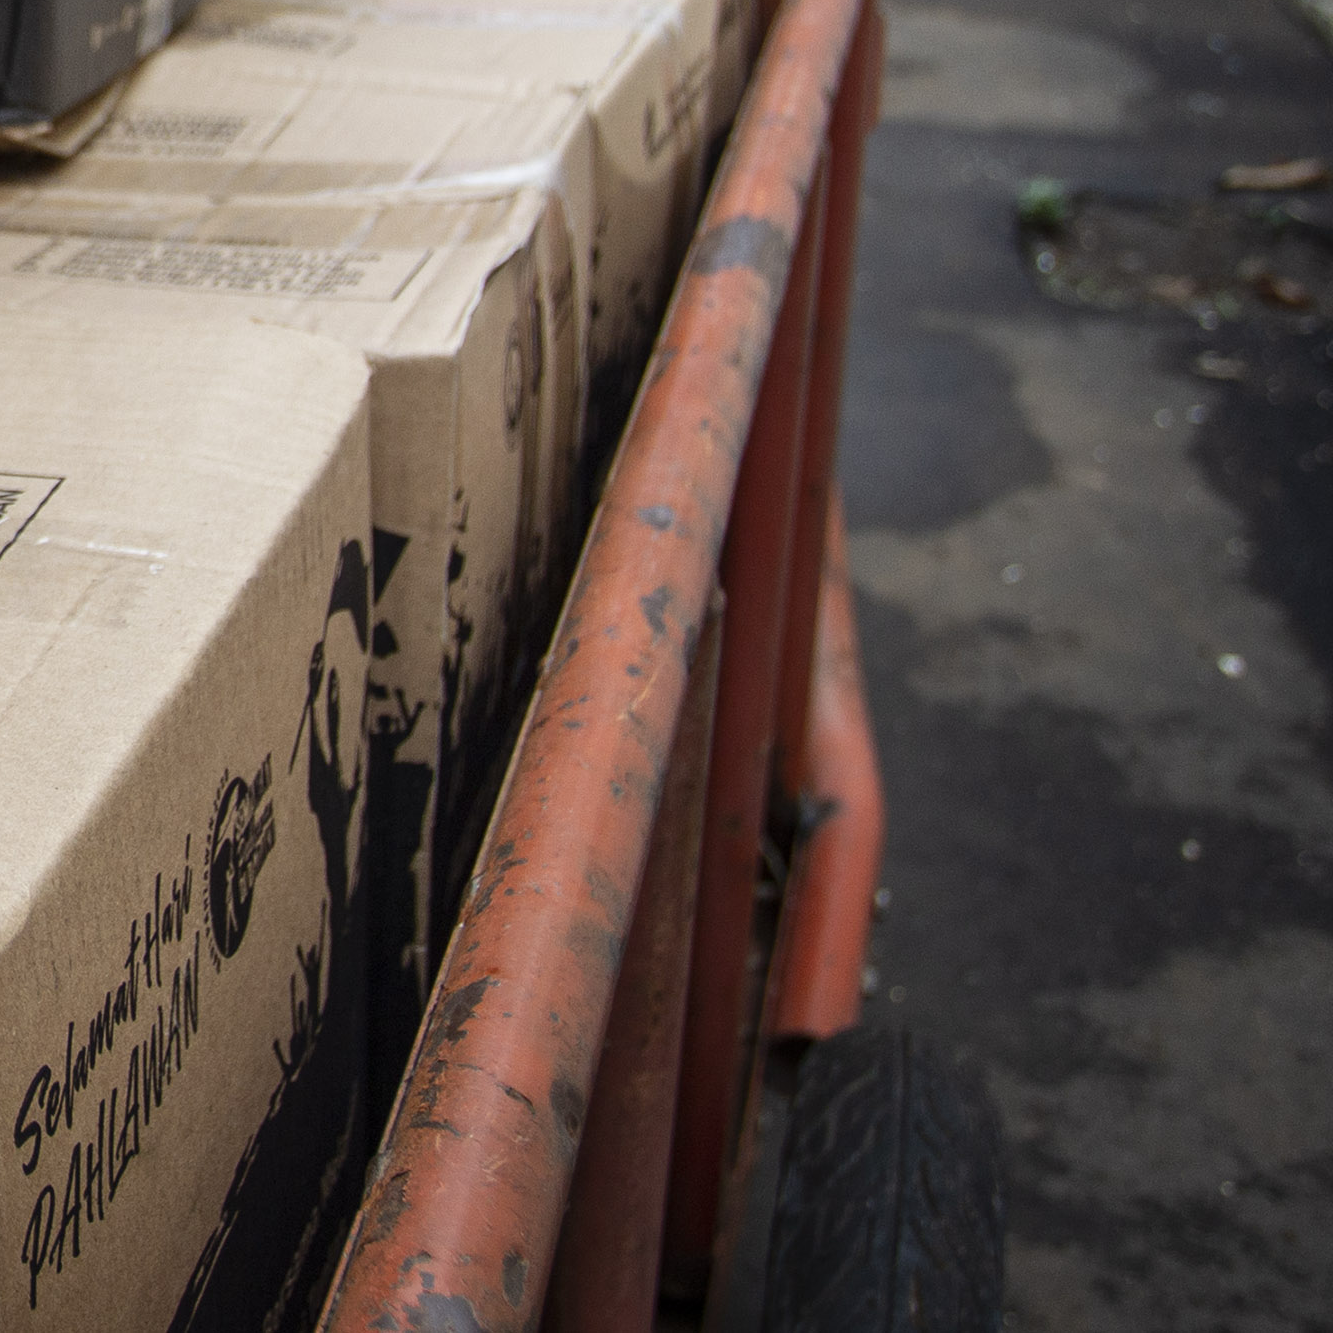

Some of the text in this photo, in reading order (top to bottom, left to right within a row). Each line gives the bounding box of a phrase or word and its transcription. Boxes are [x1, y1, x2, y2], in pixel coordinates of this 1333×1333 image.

[14, 833, 193, 1175] Selamat Hari
[22, 931, 200, 1310] PAHLAWAN
